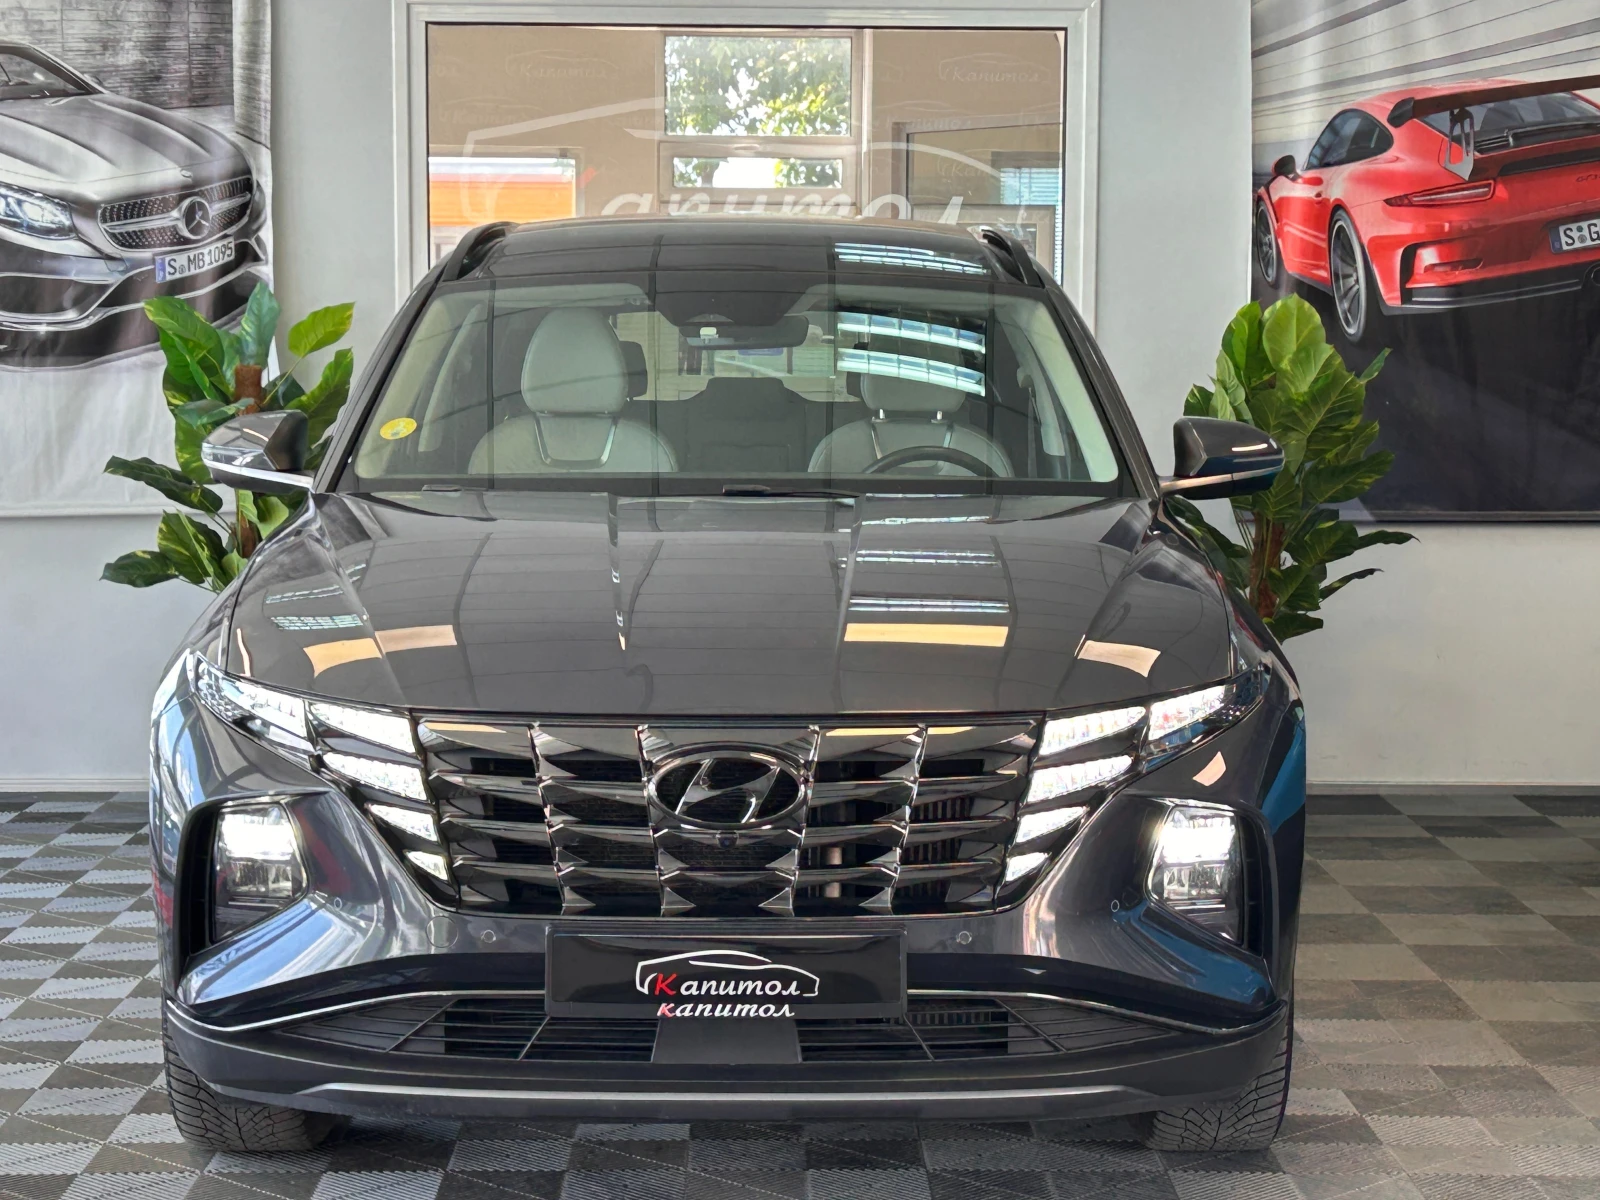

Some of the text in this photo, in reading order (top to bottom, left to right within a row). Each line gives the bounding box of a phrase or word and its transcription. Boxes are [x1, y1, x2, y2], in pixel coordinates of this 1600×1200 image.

[1563, 227, 1576, 247] S
[167, 258, 177, 276] S
[654, 973, 801, 996] Капитол
